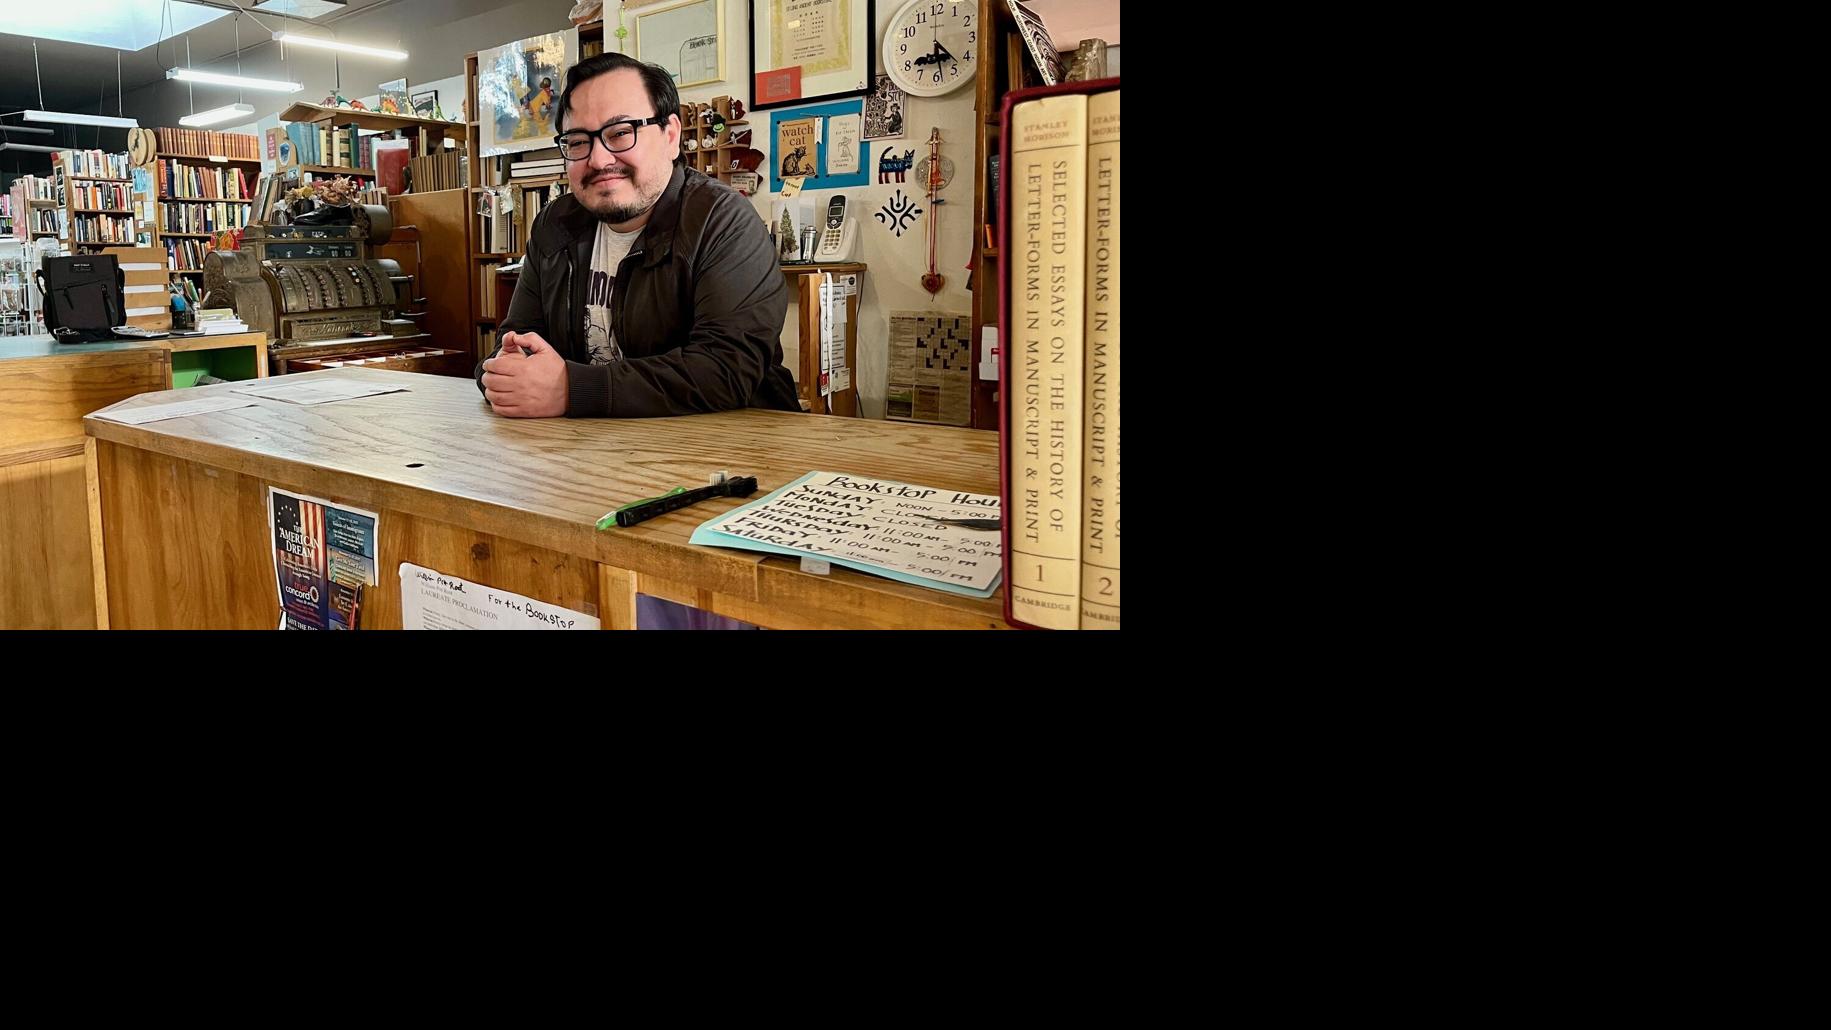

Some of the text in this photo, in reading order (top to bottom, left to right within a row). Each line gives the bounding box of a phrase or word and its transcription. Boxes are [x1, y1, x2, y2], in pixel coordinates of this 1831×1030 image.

[929, 3, 944, 16] 12
[951, 6, 958, 17] 1
[915, 12, 927, 24] 11
[963, 15, 971, 27] 2
[903, 26, 915, 38] 10
[968, 31, 976, 43] 3
[900, 44, 907, 55] 9
[962, 50, 971, 61] 4
[904, 60, 911, 71] 8
[950, 64, 958, 75] 5
[917, 69, 923, 80] 7
[932, 71, 940, 82] 6
[782, 124, 814, 137] watch
[1024, 121, 1067, 132] STANLEY
[789, 136, 806, 147] cat
[1023, 131, 1069, 142] MORISON
[1049, 160, 1067, 533] SELECTED ESSAYS ON THE HISTORY OF
[1025, 164, 1041, 544] LETTER-FORMS IN MANUSCRIPT & PRINT
[1089, 157, 1112, 554] LETTER-FORMS IN MANUSCRIPT & PRINT
[896, 502, 934, 512] NOON
[872, 516, 947, 530] CLOSED
[279, 527, 320, 549] AMERICAN
[830, 537, 869, 550] 11:00
[863, 533, 901, 545] 11:00
[286, 540, 313, 558] DREAM
[951, 573, 973, 582] PM
[1035, 564, 1045, 582] 1
[1098, 576, 1114, 596] 2
[285, 585, 311, 601] concord
[421, 589, 452, 607] LAUREATE
[452, 598, 498, 620] PROCLAMATION
[488, 594, 502, 605] For
[504, 600, 521, 612] the
[1015, 595, 1071, 611] CAMBRIDGE
[296, 620, 307, 630] THE
